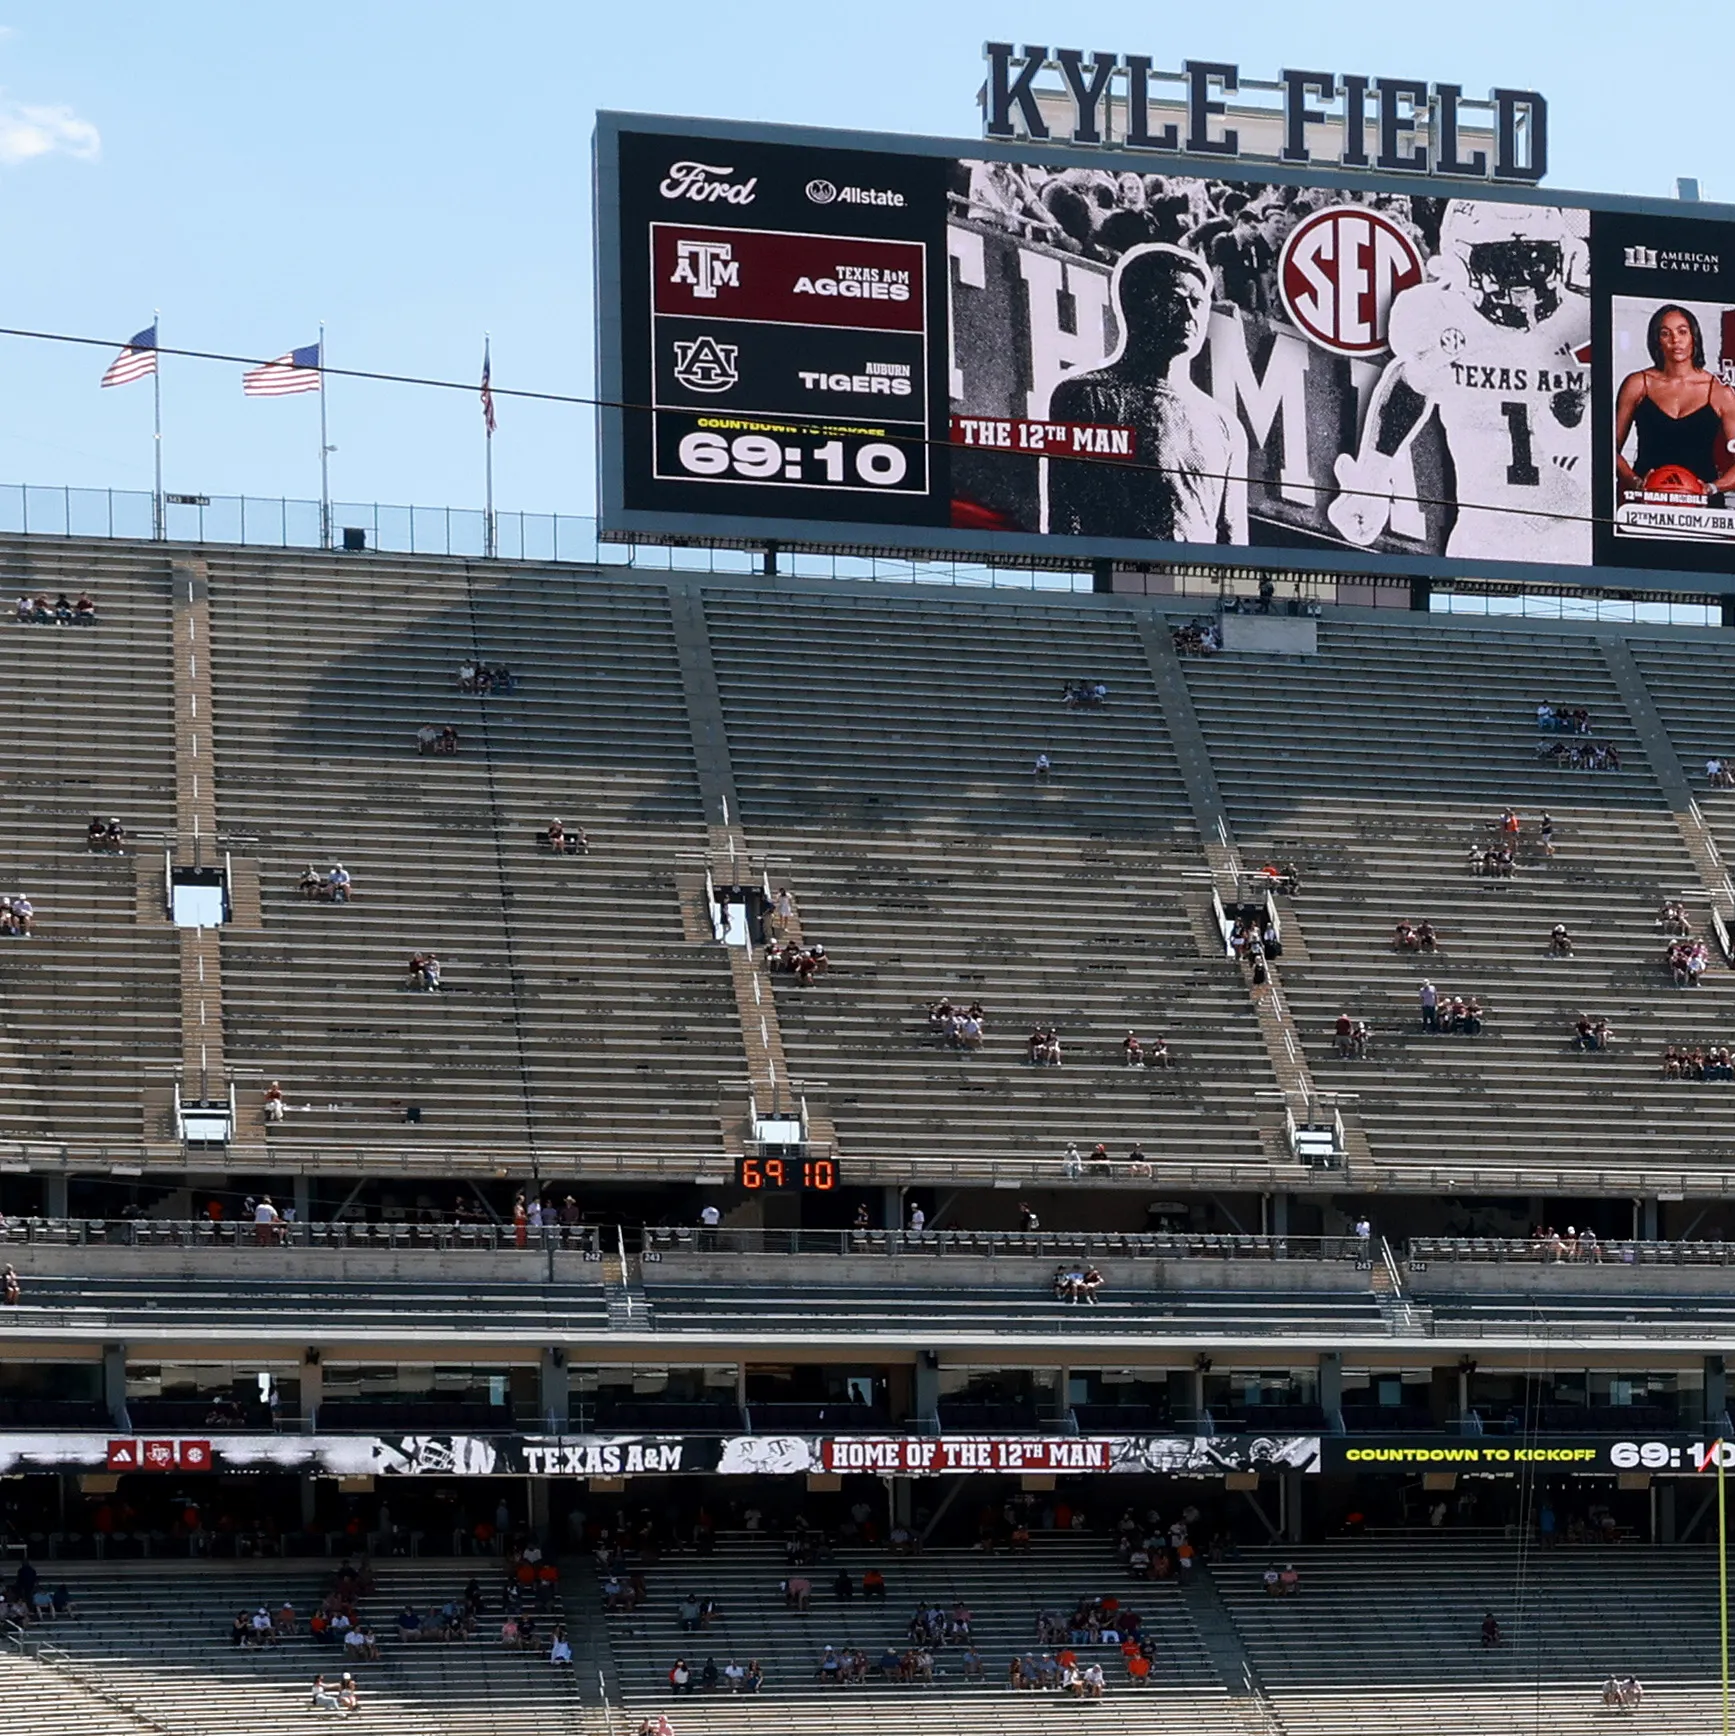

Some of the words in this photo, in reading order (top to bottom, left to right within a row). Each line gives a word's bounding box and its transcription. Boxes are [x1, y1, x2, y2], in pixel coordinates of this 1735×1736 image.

[982, 41, 1240, 157] KYLE
[1279, 67, 1549, 185] FIELD
[659, 161, 757, 205] Ford
[837, 186, 905, 207] Allstate
[1660, 261, 1720, 274] CAMPUS
[1661, 251, 1719, 263] AMERICAN
[836, 266, 879, 282] TEXAS
[883, 269, 909, 283] A&M
[793, 277, 910, 301] AGGIES
[865, 362, 911, 377] AUBURN
[1450, 361, 1528, 390] TEXAS
[1537, 370, 1585, 392] A&M
[799, 371, 912, 395] TIGERS
[960, 419, 1012, 447] THE
[1018, 424, 1067, 449] 12TH
[1501, 402, 1539, 486] 1
[679, 432, 907, 485] 69:10
[523, 1447, 621, 1473] TEXAS
[625, 1446, 684, 1471] A&M
[832, 1444, 900, 1467] HOME
[905, 1444, 936, 1467] OF
[942, 1444, 992, 1467] THE
[998, 1444, 1043, 1468] 12TH
[1346, 1448, 1478, 1462] COUNTDOWN
[1482, 1448, 1511, 1462] TO
[1514, 1448, 1597, 1462] KICKOFF
